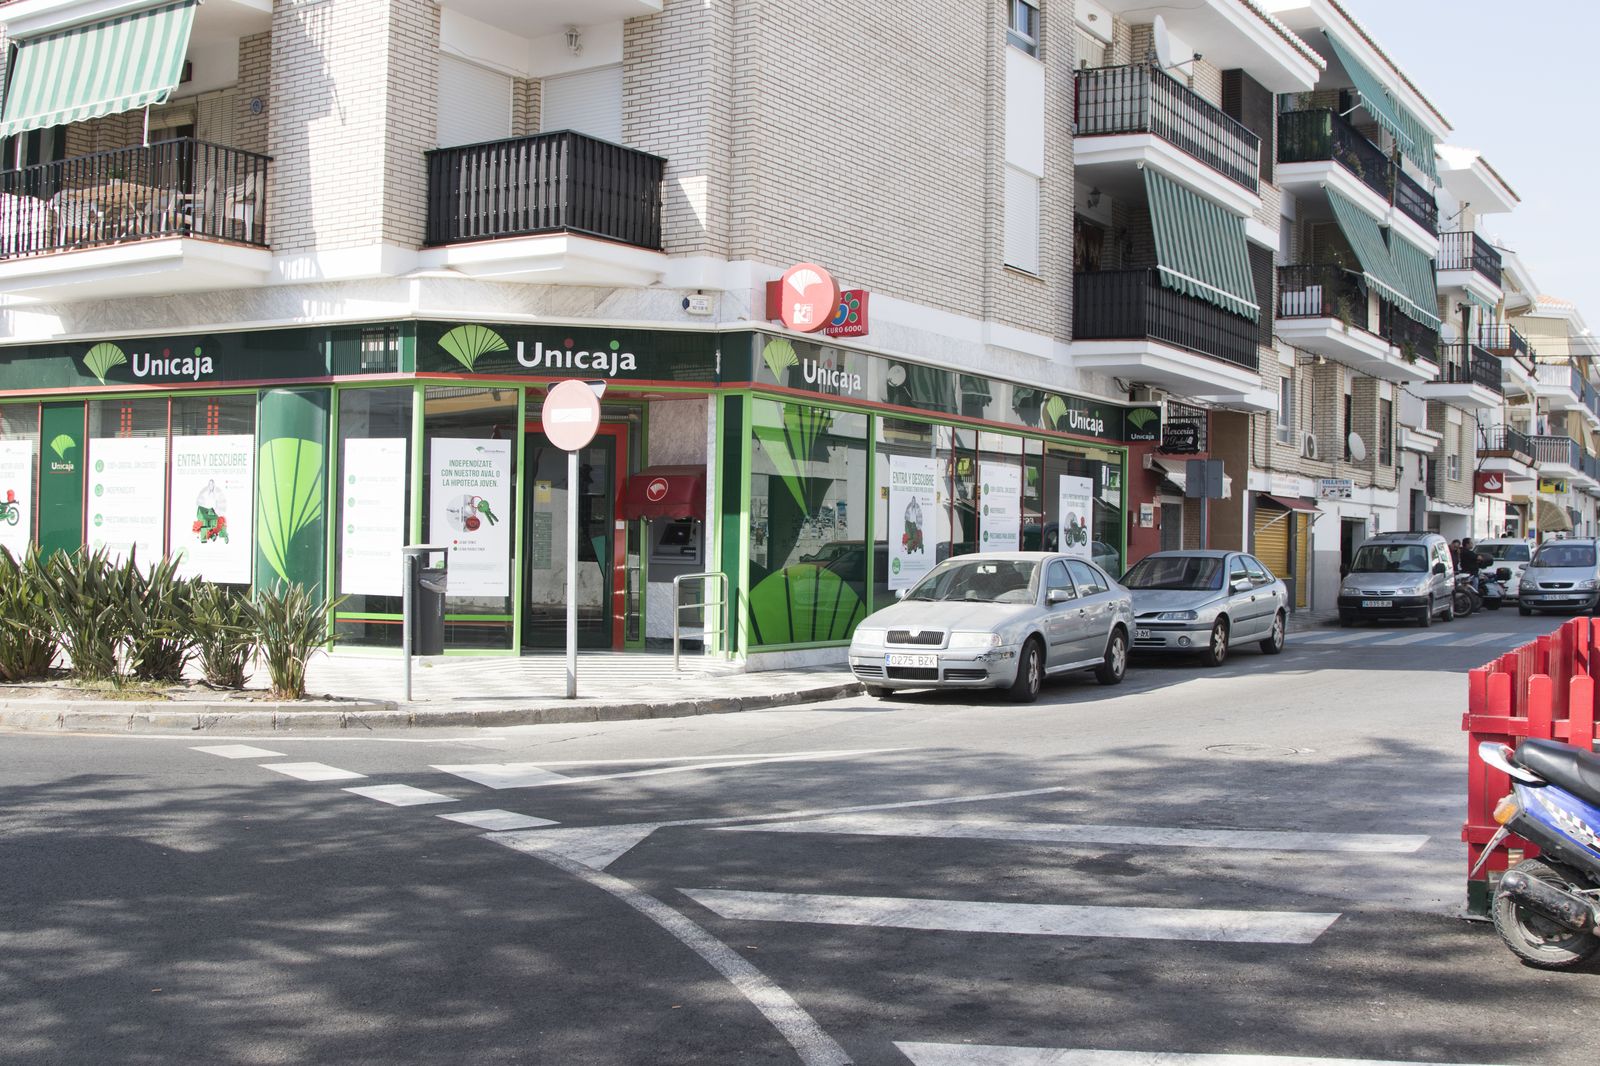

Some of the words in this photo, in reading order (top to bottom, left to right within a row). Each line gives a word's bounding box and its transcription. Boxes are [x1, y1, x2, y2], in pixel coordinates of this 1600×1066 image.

[844, 325, 862, 333] 6000
[517, 338, 637, 377] Unicaja
[132, 347, 214, 382] Unicaja
[803, 358, 862, 395] Unicaja
[1069, 408, 1105, 437] Unicaja
[1130, 433, 1155, 441] Unicaja
[177, 453, 201, 467] ENTRA
[202, 454, 208, 467] Y
[209, 453, 248, 466] DESCUBRE
[51, 461, 75, 472] Unicaja
[441, 469, 453, 477] CON
[454, 469, 480, 478] NUESTRO
[481, 470, 495, 478] AVAL
[892, 471, 907, 484] ENTRA
[908, 472, 912, 484] Y
[912, 473, 935, 487] DESCUBRE
[442, 479, 450, 487] LA
[451, 479, 478, 487] HIPOTECA
[891, 655, 914, 666] 0275
[918, 656, 935, 666] BZK
